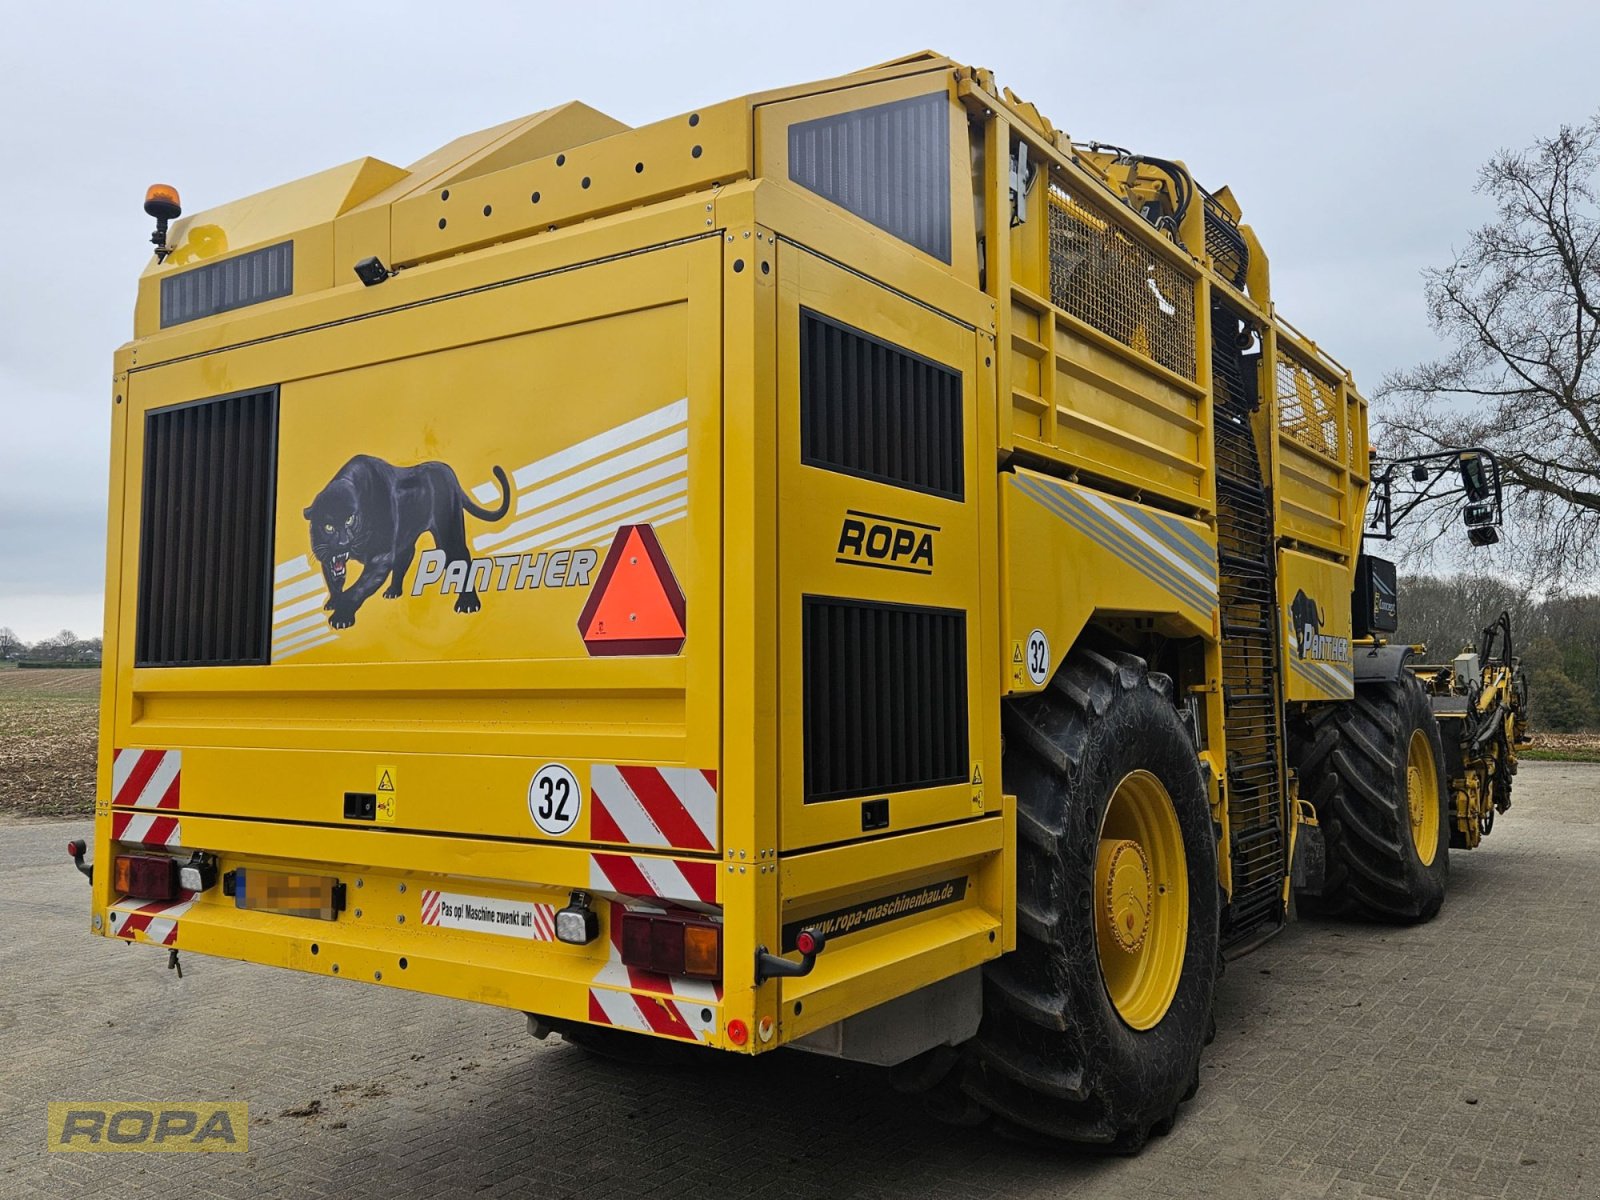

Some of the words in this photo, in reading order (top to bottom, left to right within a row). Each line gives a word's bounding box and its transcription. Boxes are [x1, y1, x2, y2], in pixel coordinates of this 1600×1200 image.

[837, 518, 934, 567] ROPA
[411, 548, 598, 597] PANTHER
[1031, 640, 1045, 673] 32
[1303, 623, 1348, 662] PANTHER
[538, 776, 570, 822] 32
[441, 901, 453, 917] Pas
[454, 904, 464, 921] op!
[465, 904, 495, 923] Maschine
[496, 910, 520, 925] zwenkt
[521, 912, 532, 927] uit!
